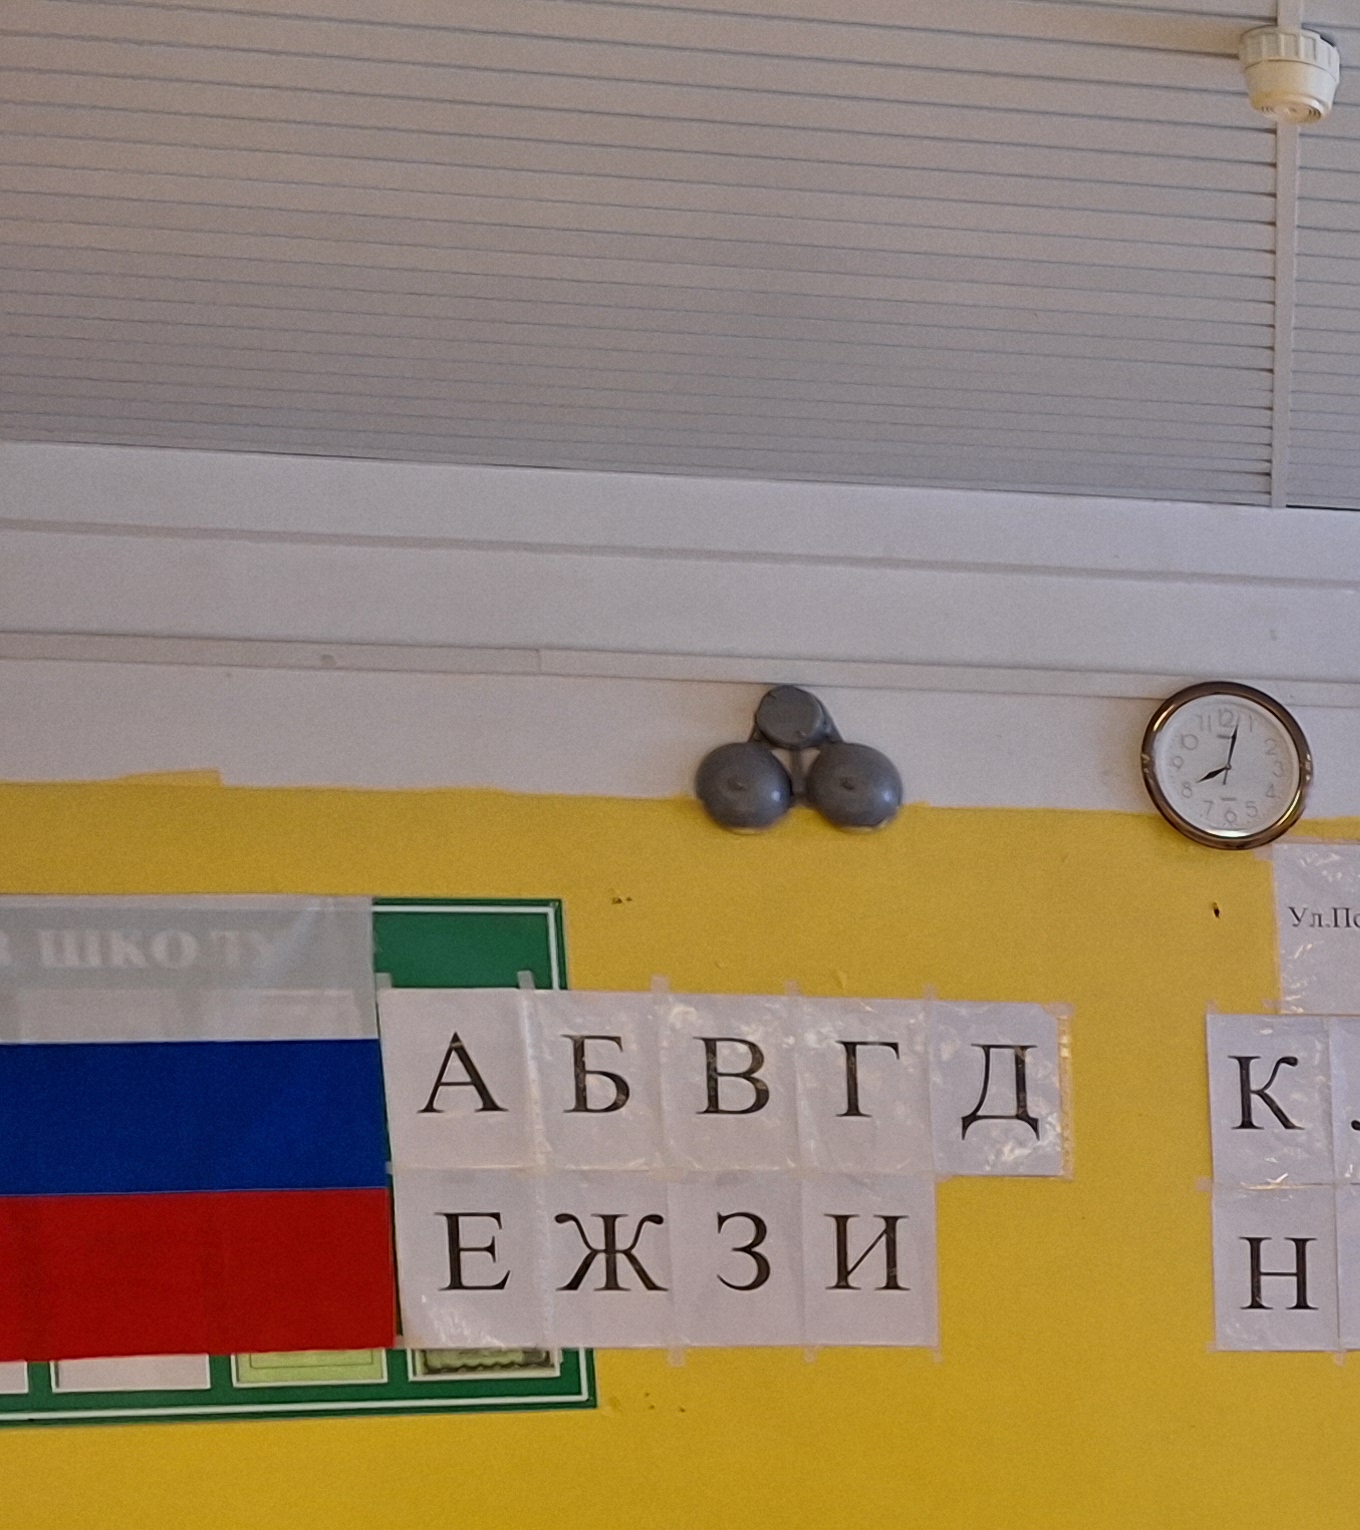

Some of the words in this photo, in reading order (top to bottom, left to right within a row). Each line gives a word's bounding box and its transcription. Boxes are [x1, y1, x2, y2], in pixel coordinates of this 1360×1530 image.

[416, 1031, 509, 1114] А
[561, 1034, 631, 1114] Б
[693, 1036, 771, 1115] В
[835, 1040, 901, 1118] Г
[960, 1043, 1040, 1141] Д
[1227, 1055, 1305, 1130] К
[434, 1211, 511, 1292] Е
[553, 1212, 669, 1292] Ж
[716, 1210, 771, 1292] З
[824, 1213, 911, 1292] И
[1238, 1236, 1320, 1311] Н
